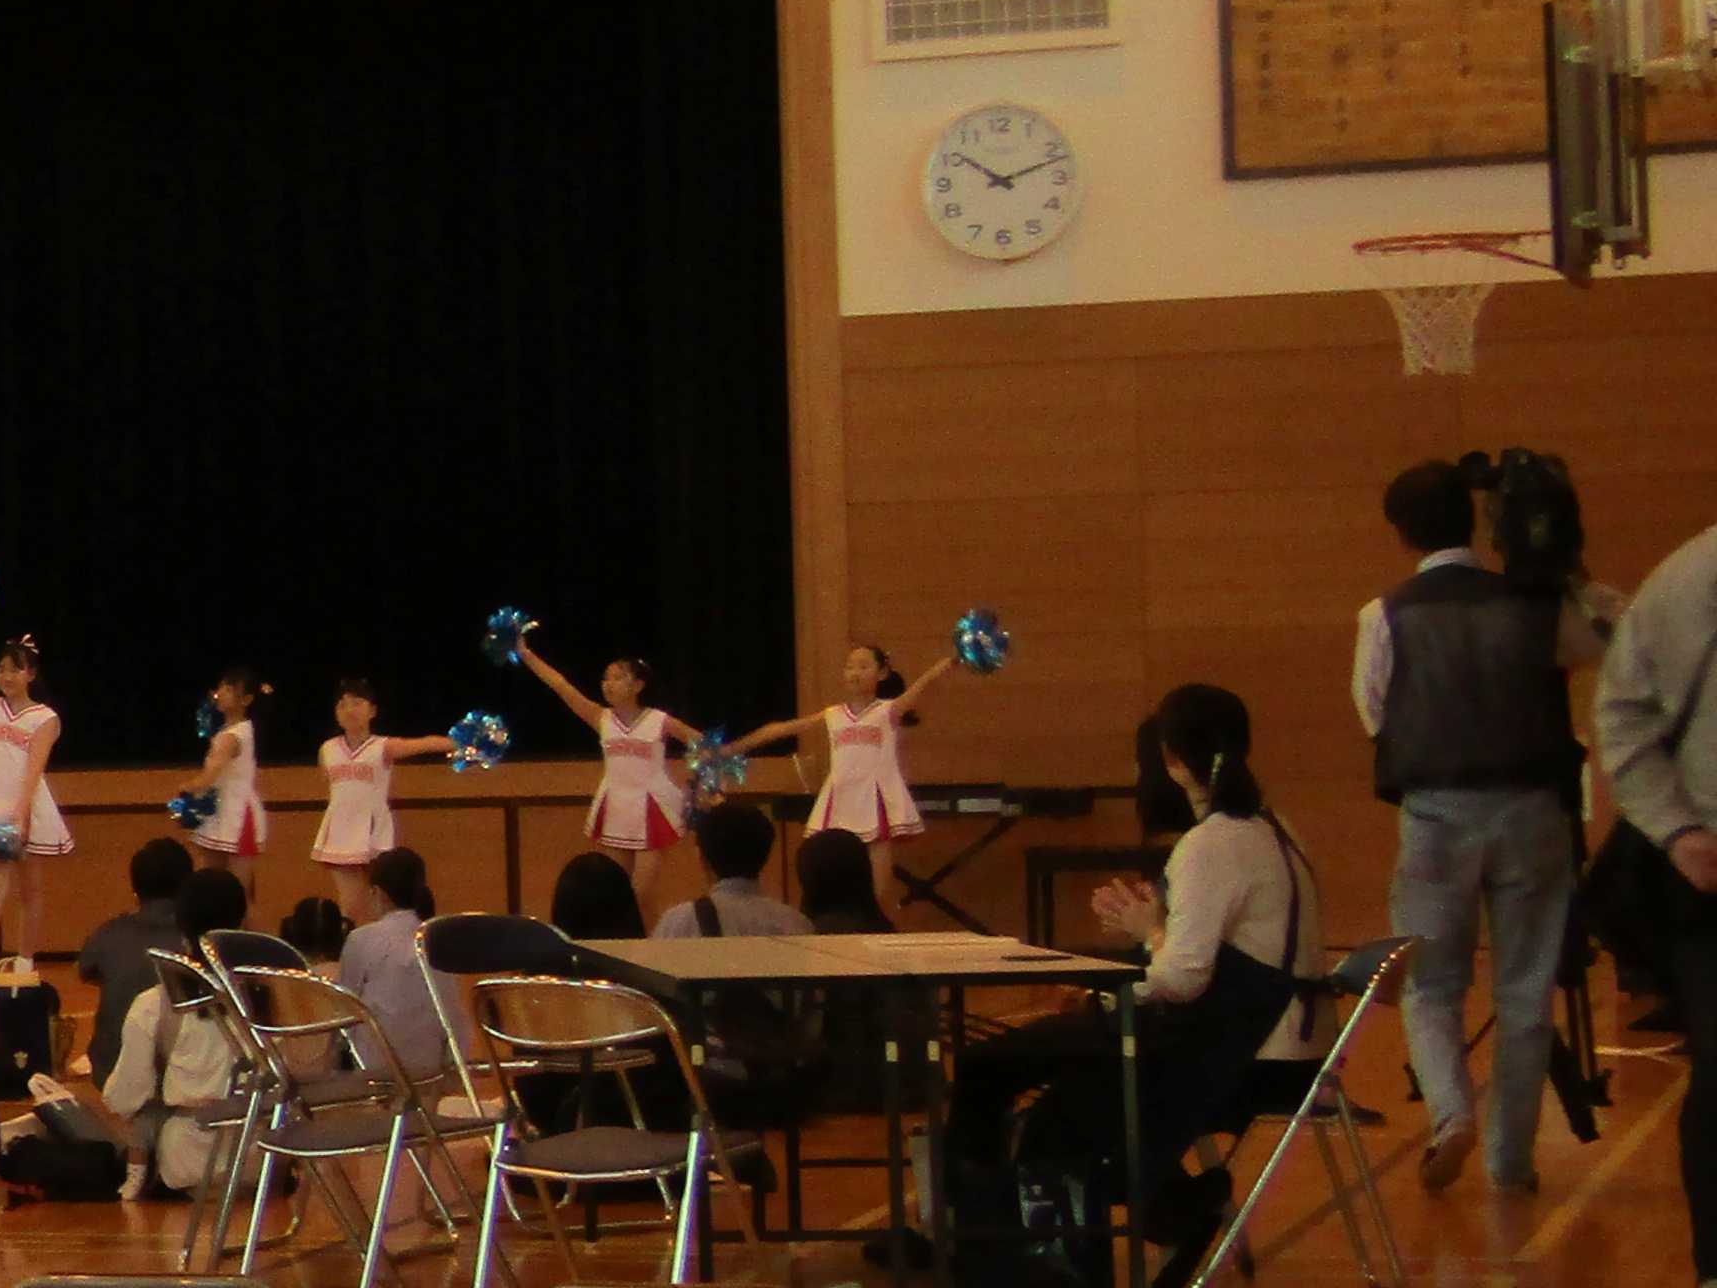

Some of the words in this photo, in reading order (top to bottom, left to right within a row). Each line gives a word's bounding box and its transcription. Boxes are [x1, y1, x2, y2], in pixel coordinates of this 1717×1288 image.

[989, 116, 1011, 133] 12
[936, 177, 952, 193] 9
[1052, 170, 1068, 186] 3
[944, 203, 962, 218] 8
[1042, 197, 1061, 211] 4
[967, 224, 983, 240] 7
[1024, 219, 1042, 235] 5
[994, 229, 1012, 244] 6
